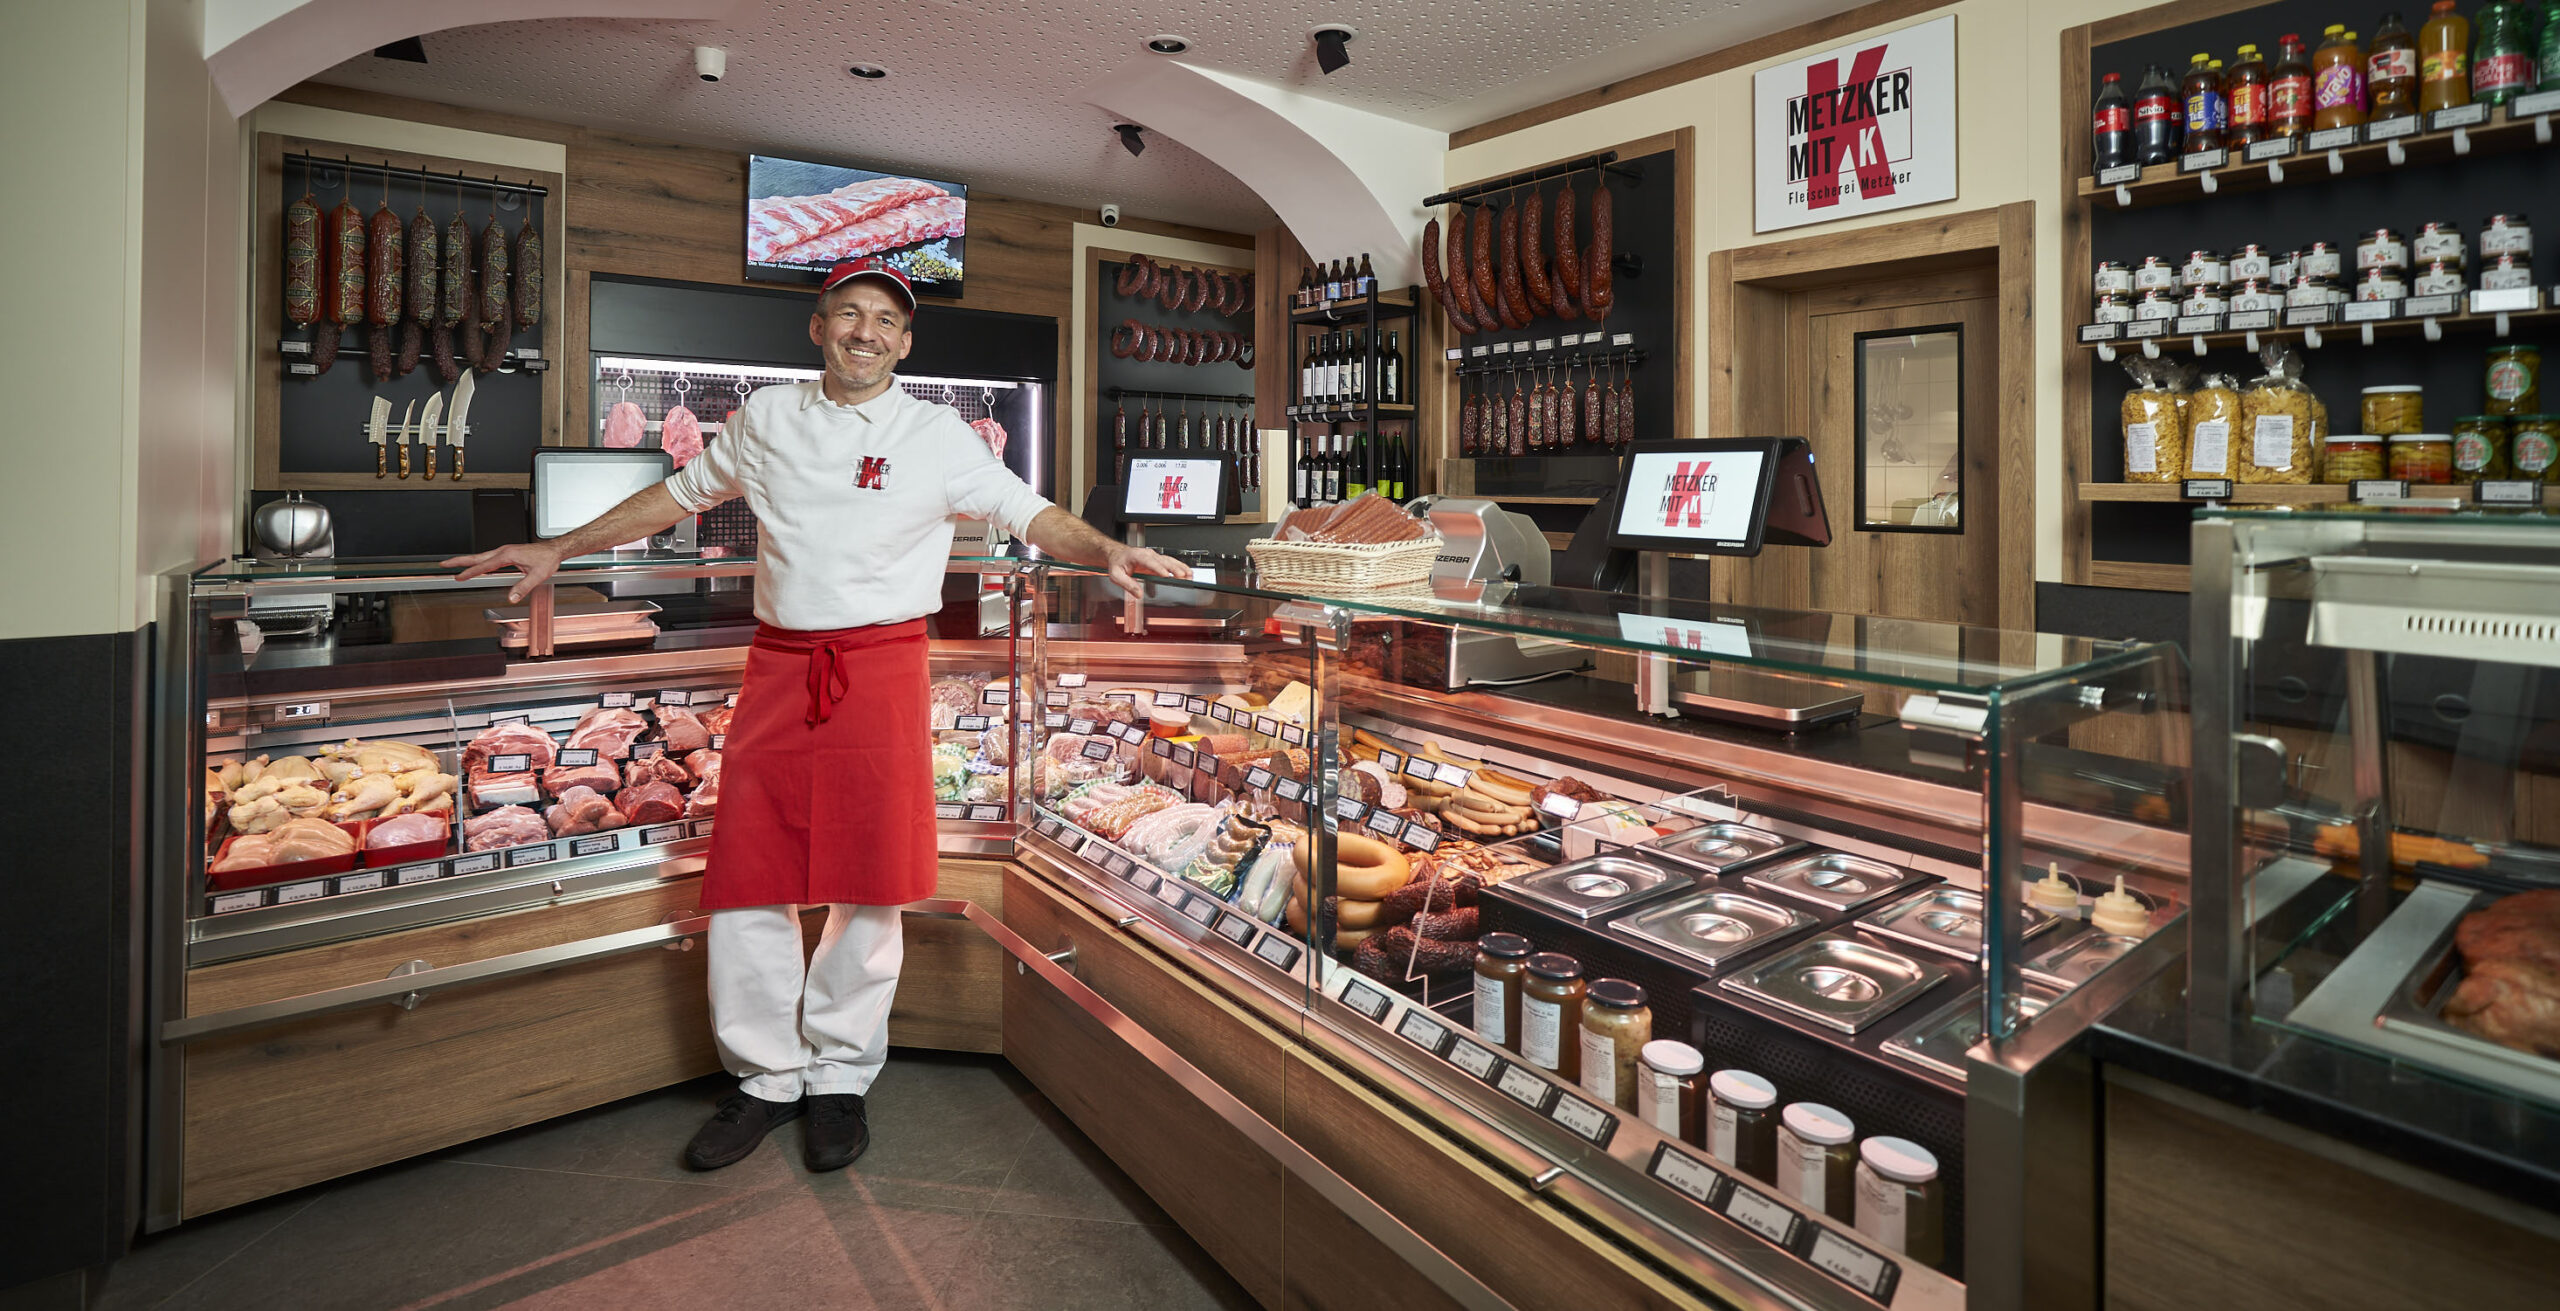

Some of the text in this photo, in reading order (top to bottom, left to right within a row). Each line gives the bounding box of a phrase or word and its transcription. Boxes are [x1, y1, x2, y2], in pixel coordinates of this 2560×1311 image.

[2318, 67, 2351, 106] bravo
[1789, 72, 1910, 136] METZKER
[2188, 101, 2204, 113] EIS
[1790, 125, 1878, 181] MIT K
[1788, 171, 1912, 205] Fleischerei Metzker
[1160, 482, 1188, 491] METZKER
[1664, 475, 1717, 492] METZKER
[1660, 495, 1701, 513] MIT K
